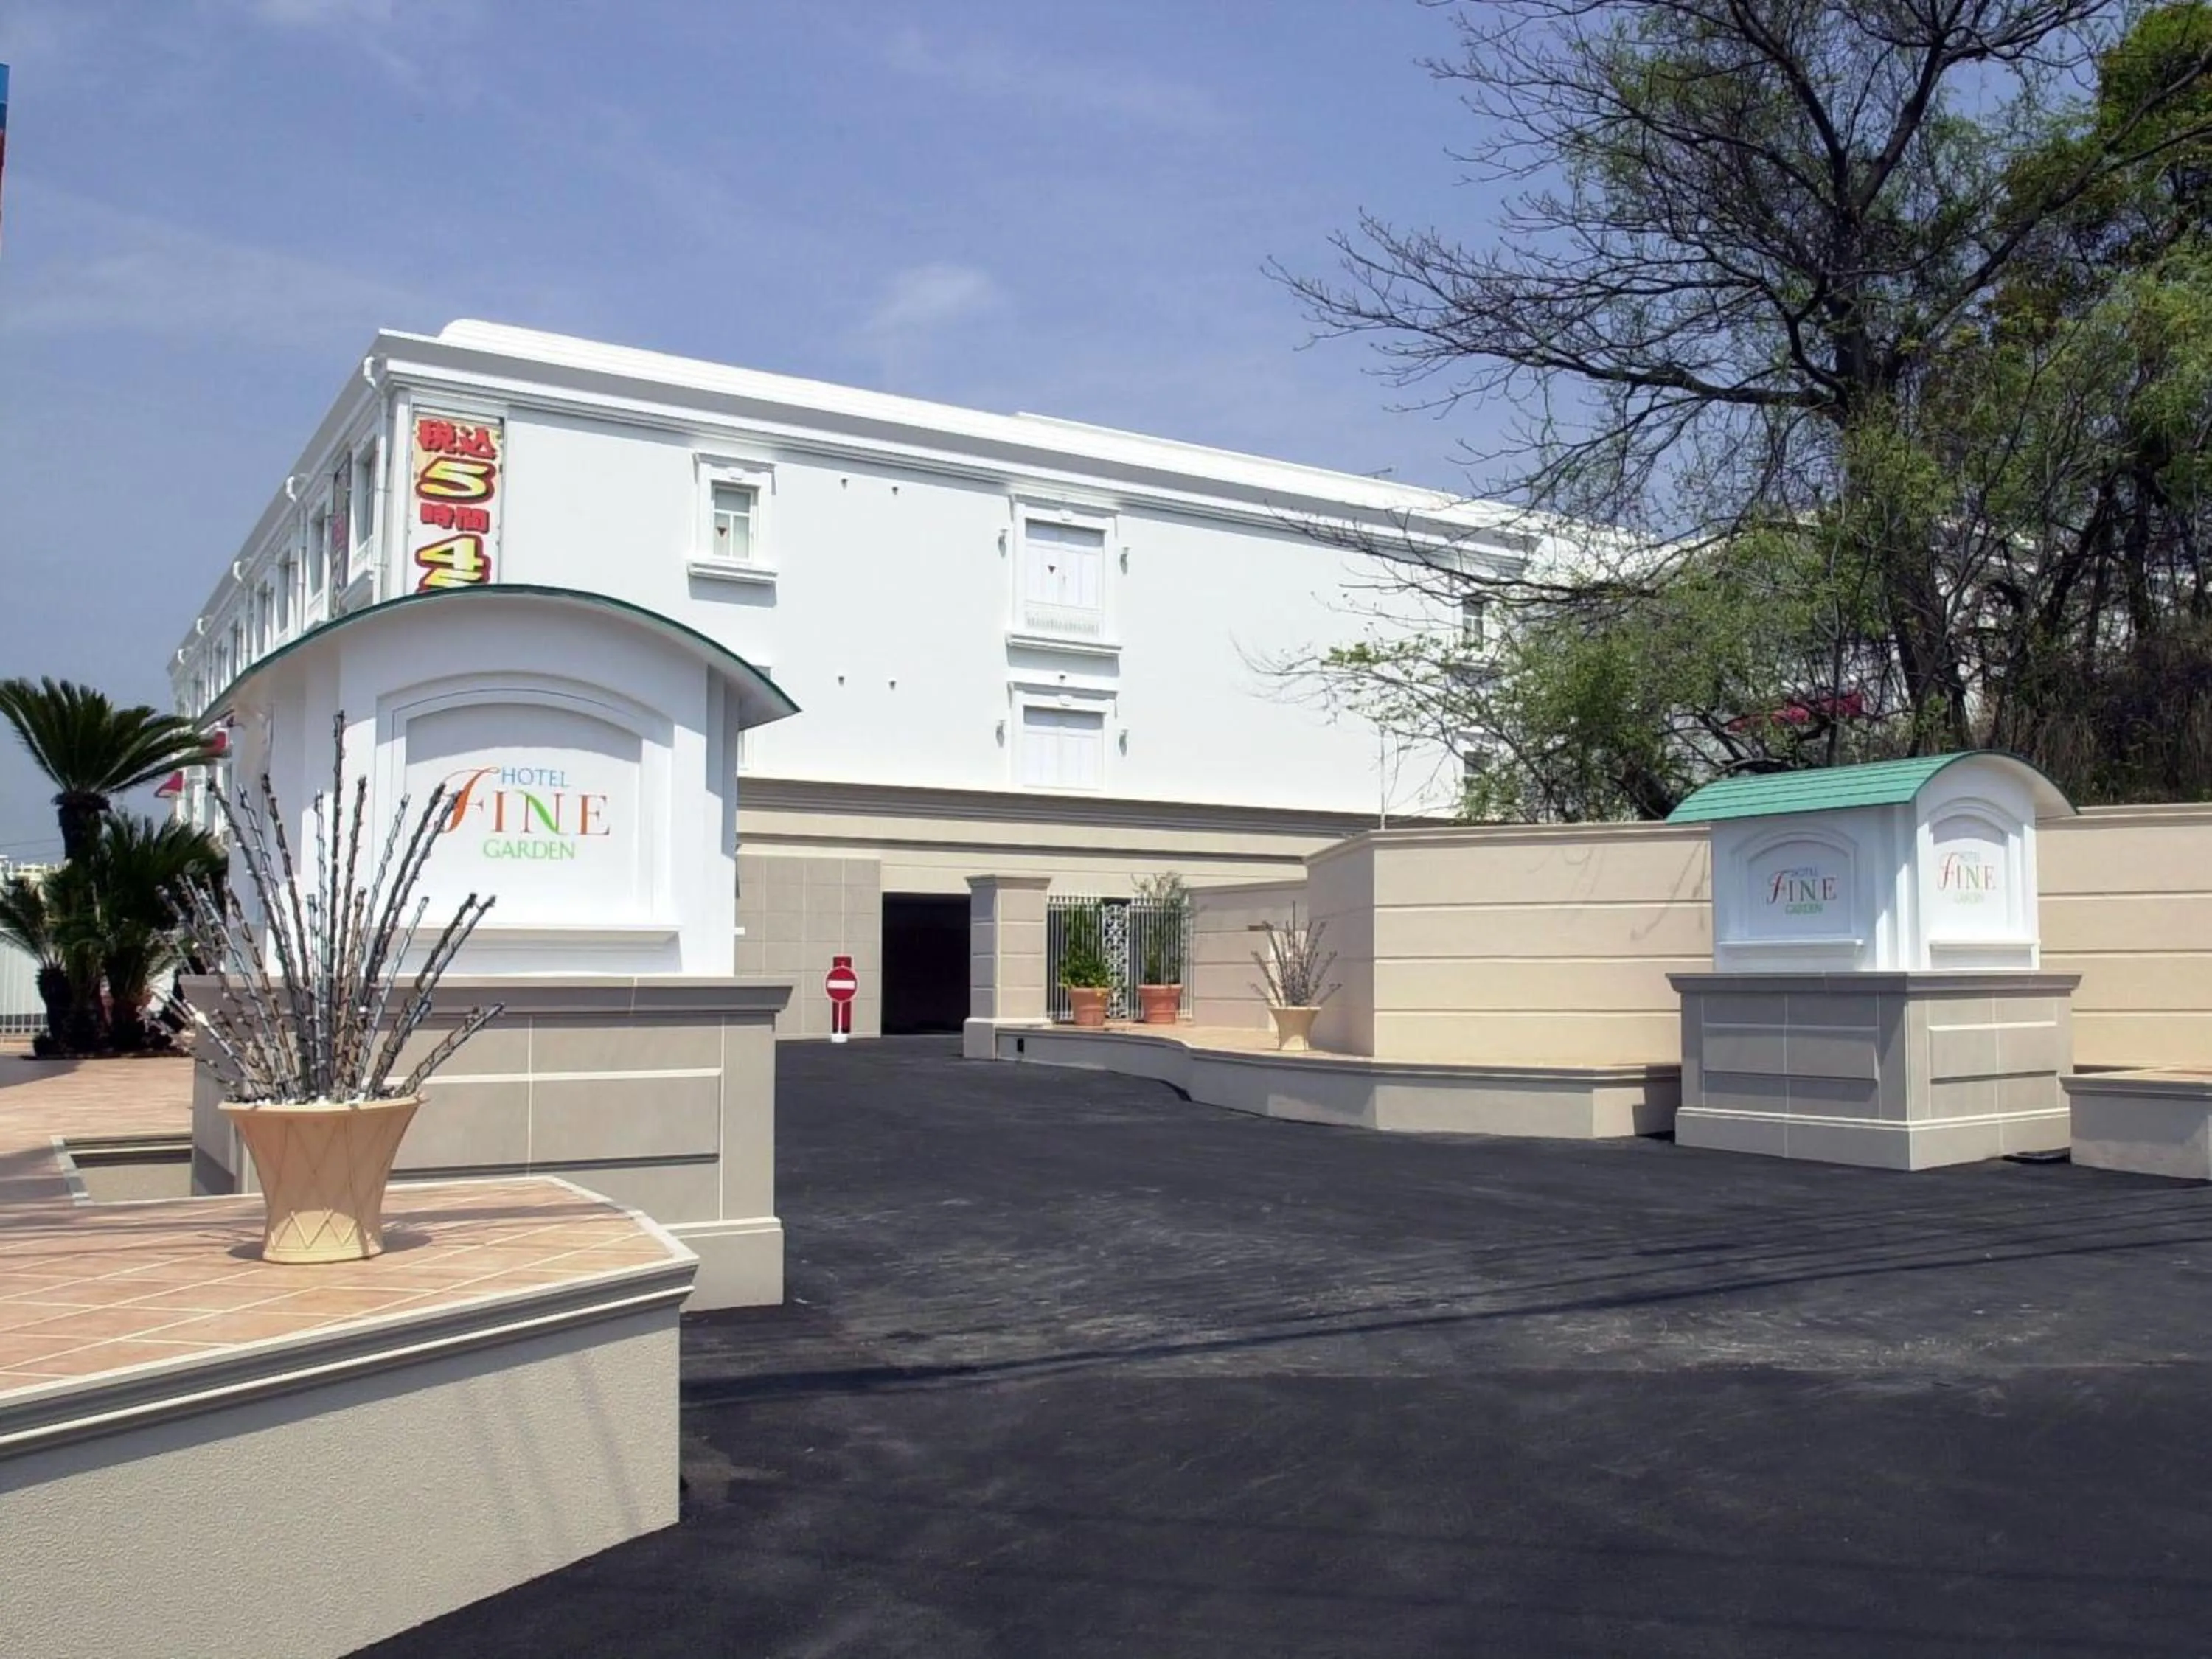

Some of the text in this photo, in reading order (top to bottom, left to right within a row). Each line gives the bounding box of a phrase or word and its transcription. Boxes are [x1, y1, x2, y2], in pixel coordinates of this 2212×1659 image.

[415, 456, 496, 504] 5
[501, 766, 570, 787] HOTEL
[441, 766, 611, 836] FINE
[482, 839, 575, 860] GARDEN
[1766, 870, 1838, 904] FINE
[1937, 852, 1997, 891] FINE
